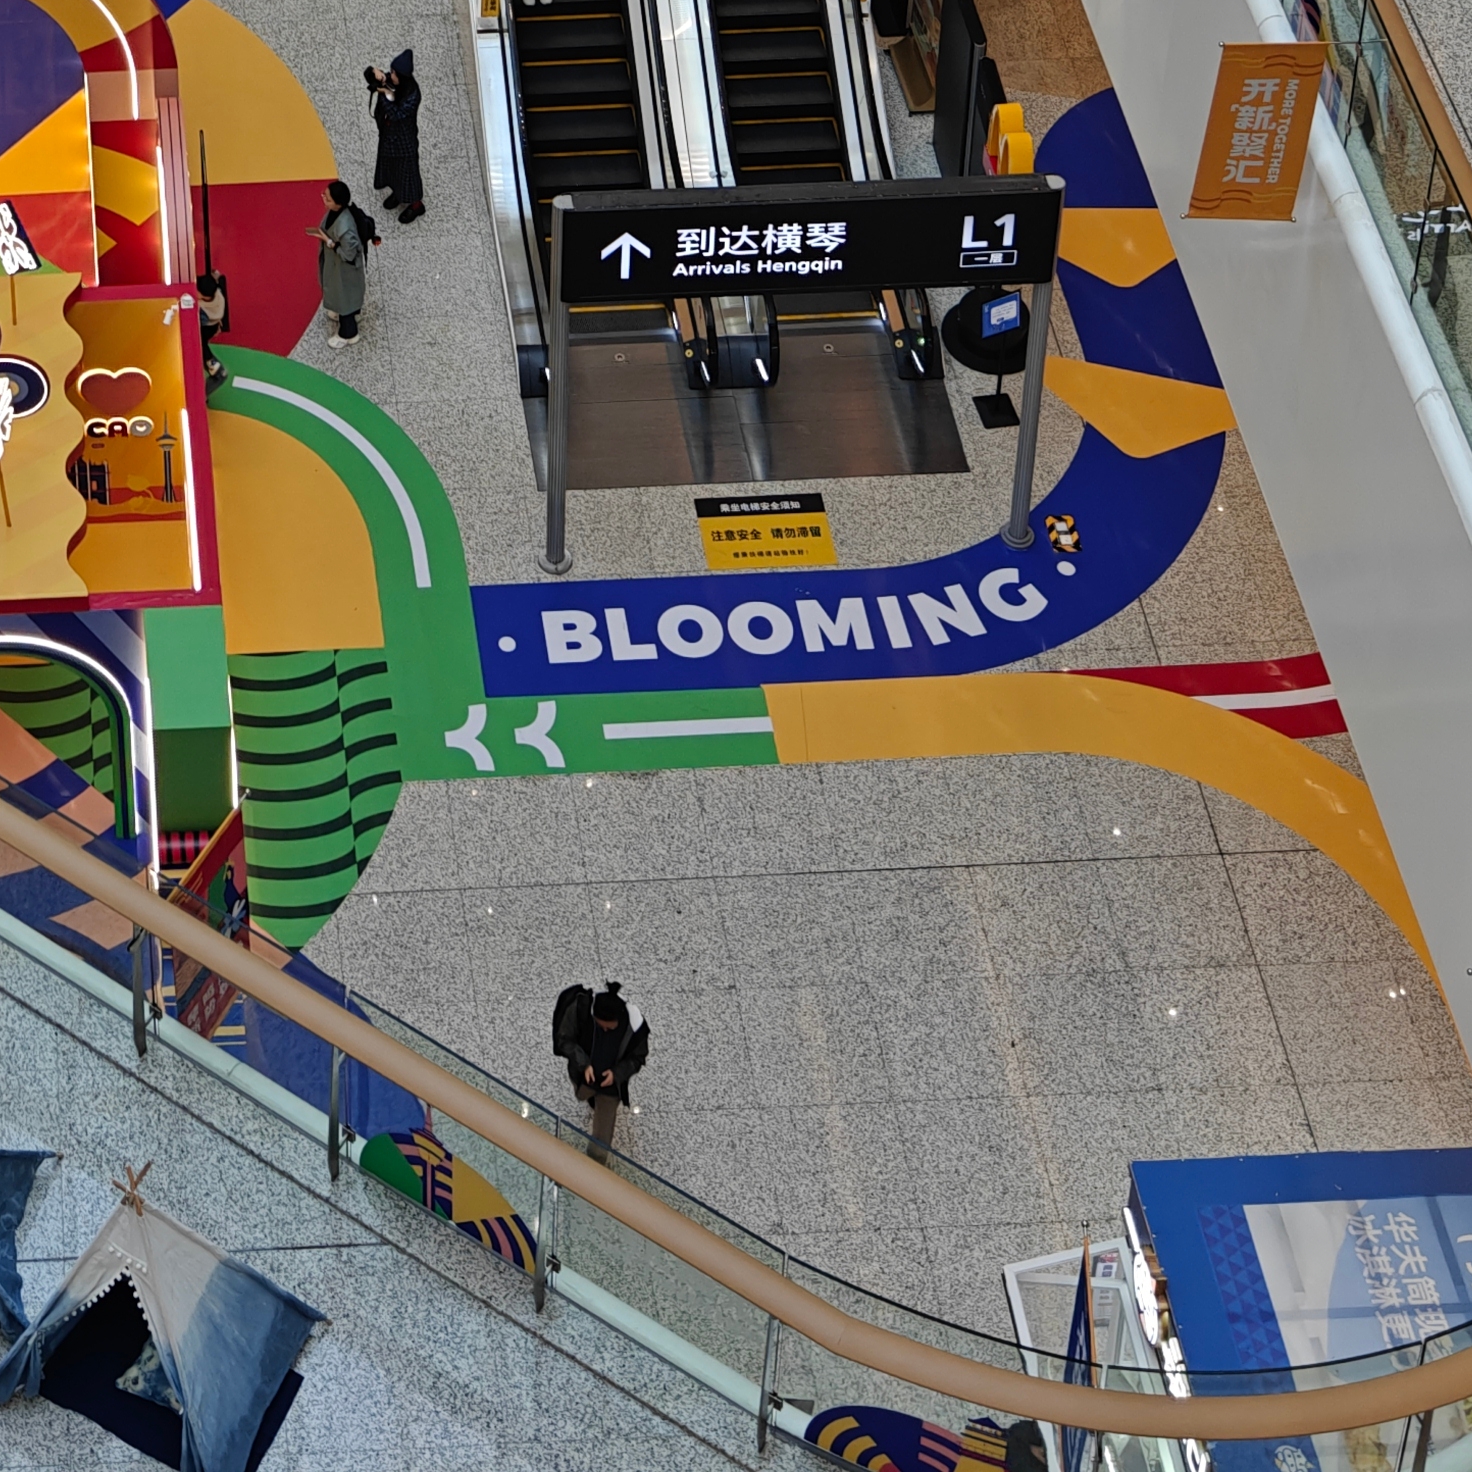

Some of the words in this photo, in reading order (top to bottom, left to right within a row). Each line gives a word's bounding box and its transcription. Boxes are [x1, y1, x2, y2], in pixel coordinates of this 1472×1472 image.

[1280, 79, 1300, 116] MORE
[1265, 117, 1292, 184] TOGETHER
[675, 221, 848, 258] 到达横琴
[960, 213, 1017, 249] L1
[672, 258, 751, 277] Arrivals
[756, 256, 843, 278] Hengqin
[973, 252, 1004, 264] 一层
[710, 527, 763, 543] 注意安全
[770, 524, 822, 541] 请勿滞留
[543, 567, 1049, 664] BLOOMING
